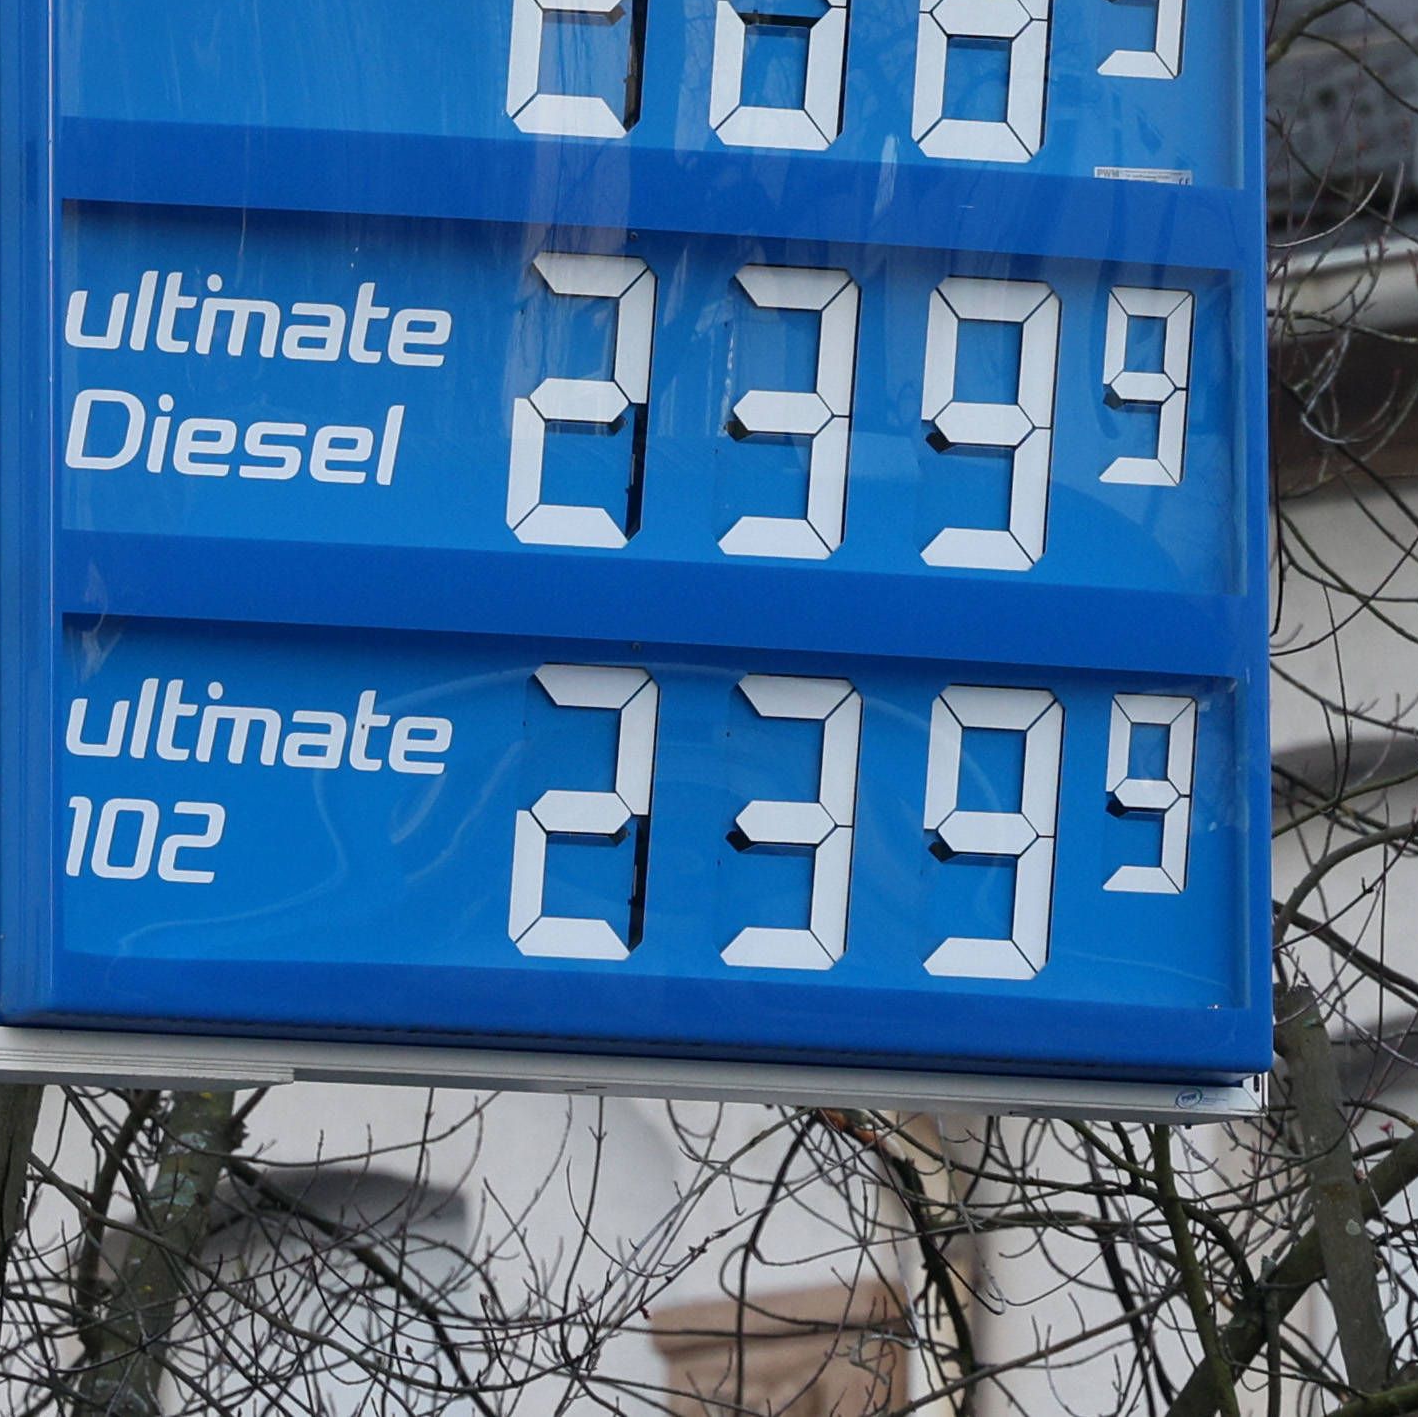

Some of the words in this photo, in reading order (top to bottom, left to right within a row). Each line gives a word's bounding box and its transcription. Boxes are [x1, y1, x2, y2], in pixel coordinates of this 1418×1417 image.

[65, 271, 451, 366] ultimate
[66, 390, 404, 484] Diesel
[67, 679, 452, 774] ultimate
[67, 797, 225, 882] 102
